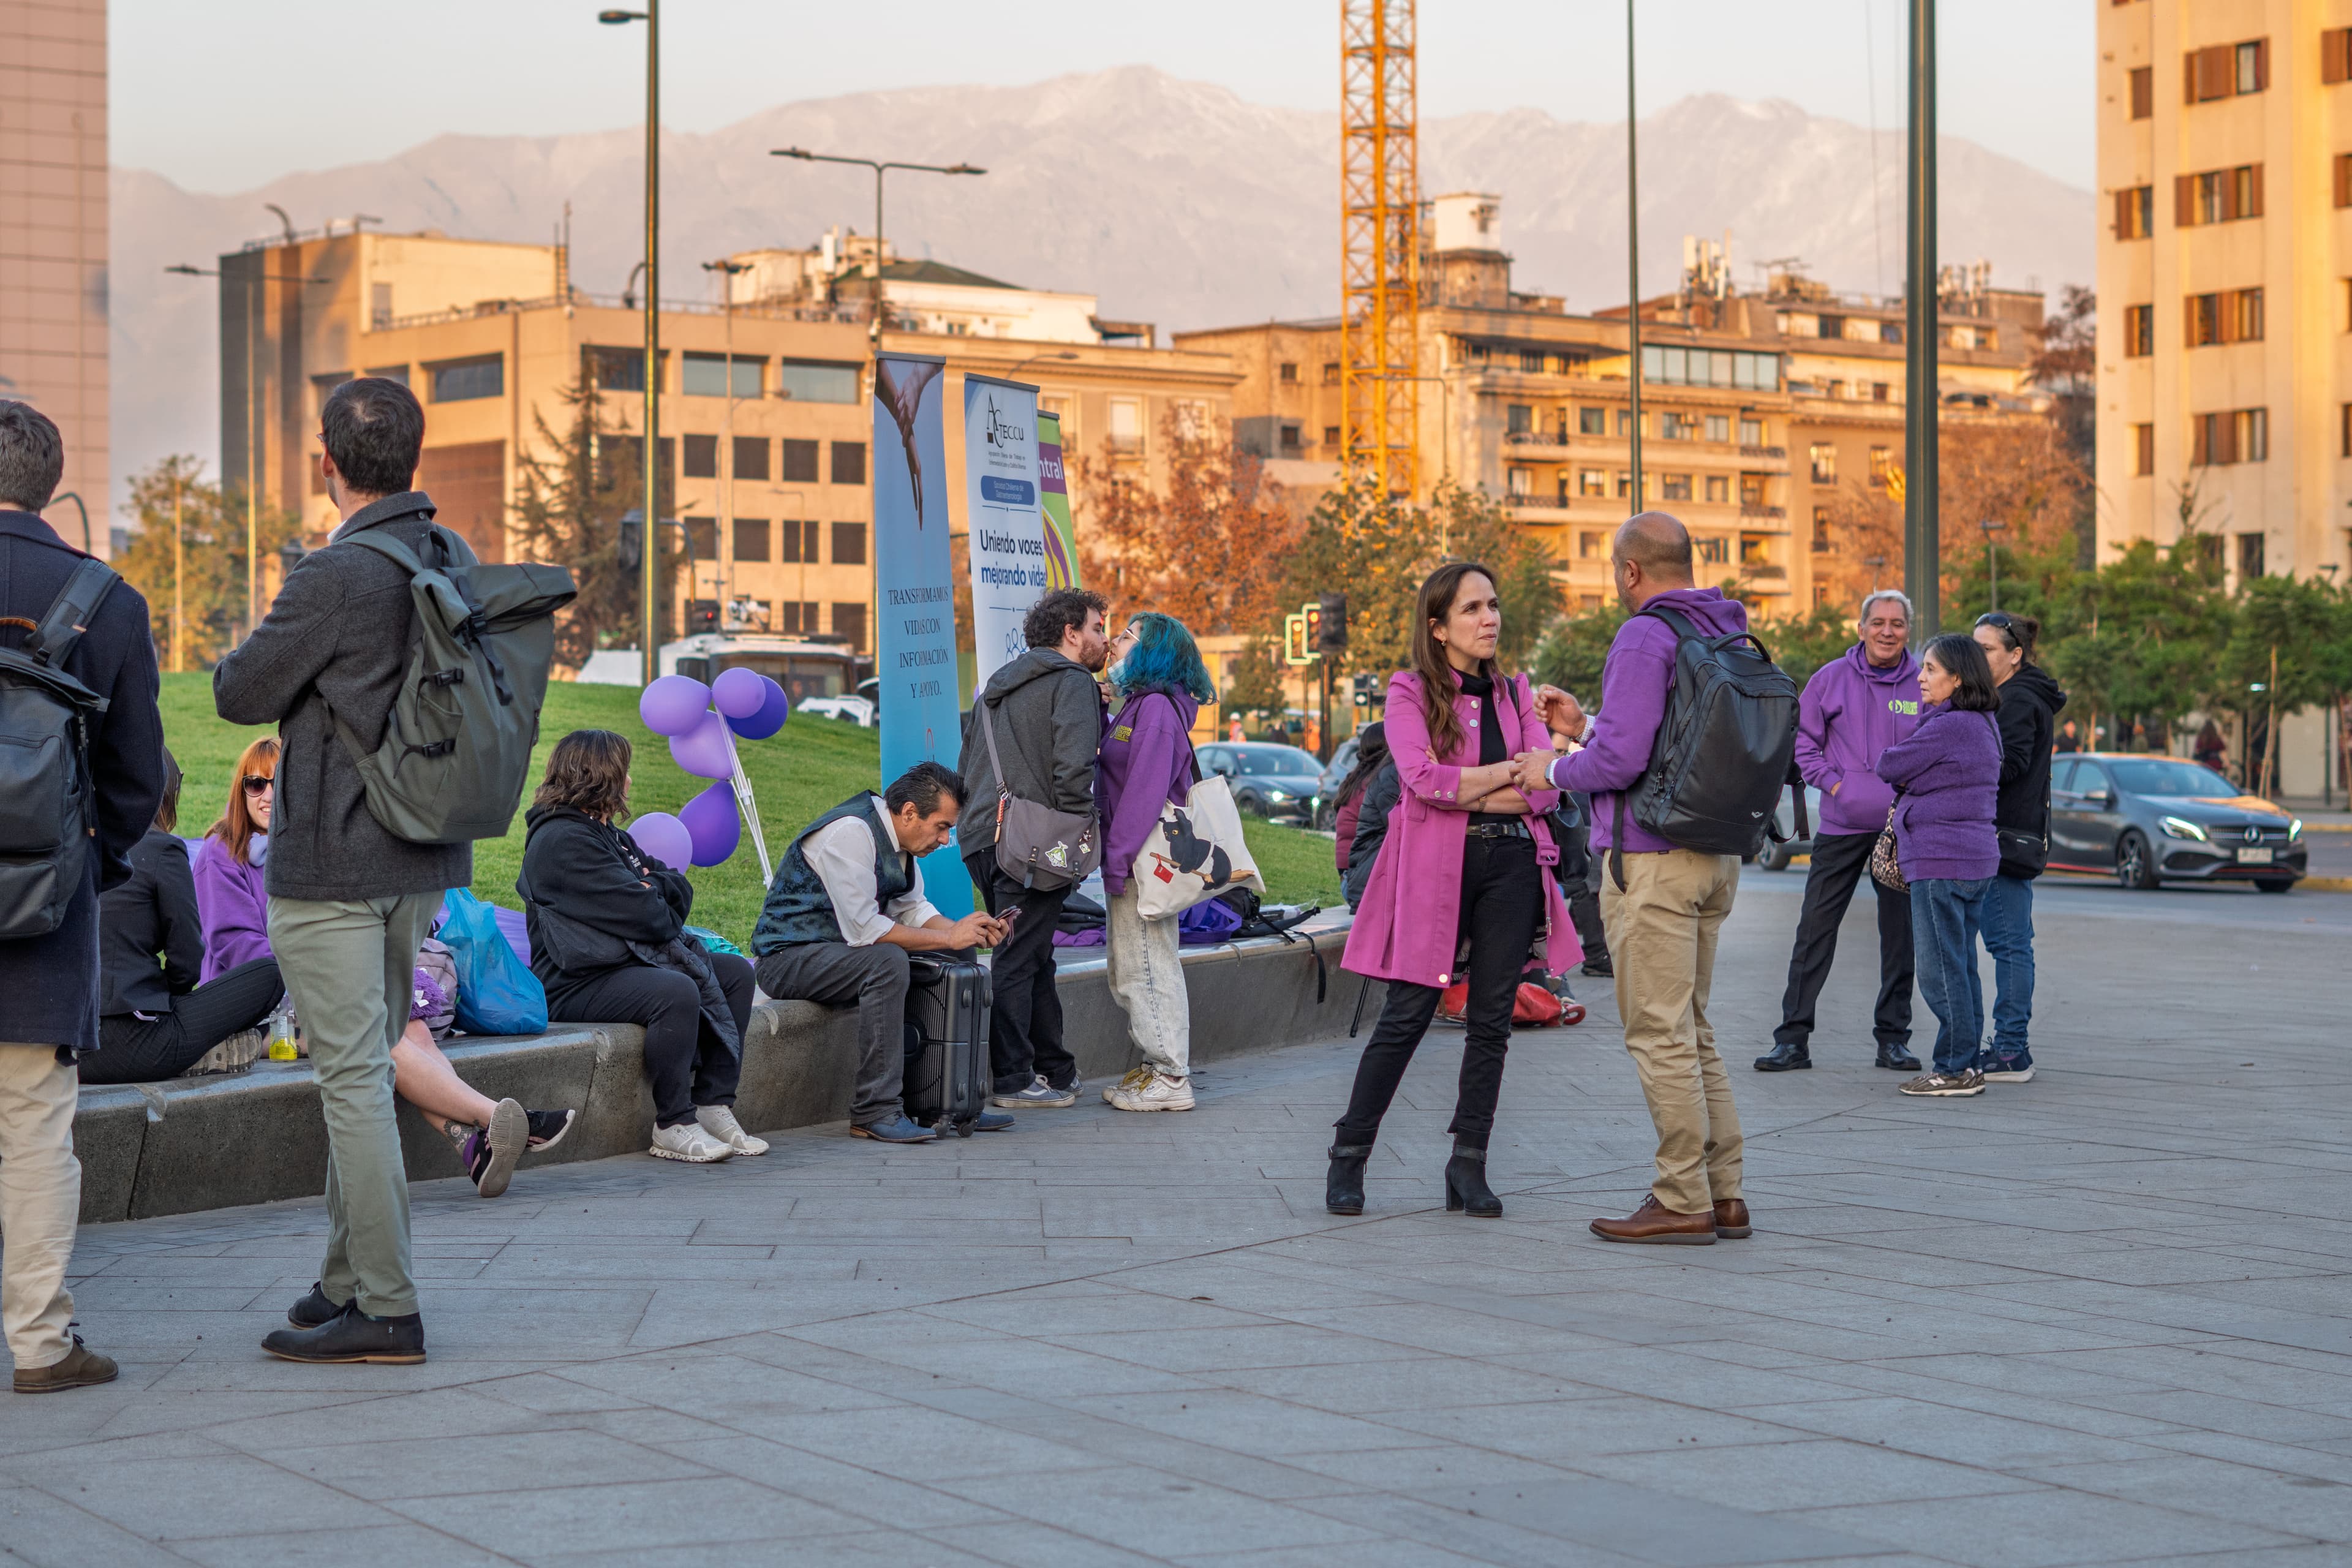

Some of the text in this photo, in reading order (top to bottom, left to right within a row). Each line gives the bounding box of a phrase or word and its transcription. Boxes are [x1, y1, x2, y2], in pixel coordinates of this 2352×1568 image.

[980, 529, 1044, 560] Uniendo voces,
[981, 562, 1026, 589] mejorando
[888, 586, 948, 605] TRANSFORMAMOS
[925, 618, 940, 633] CON
[899, 646, 948, 668] INFORMACIÓN
[910, 680, 941, 698] Y APOYO.
